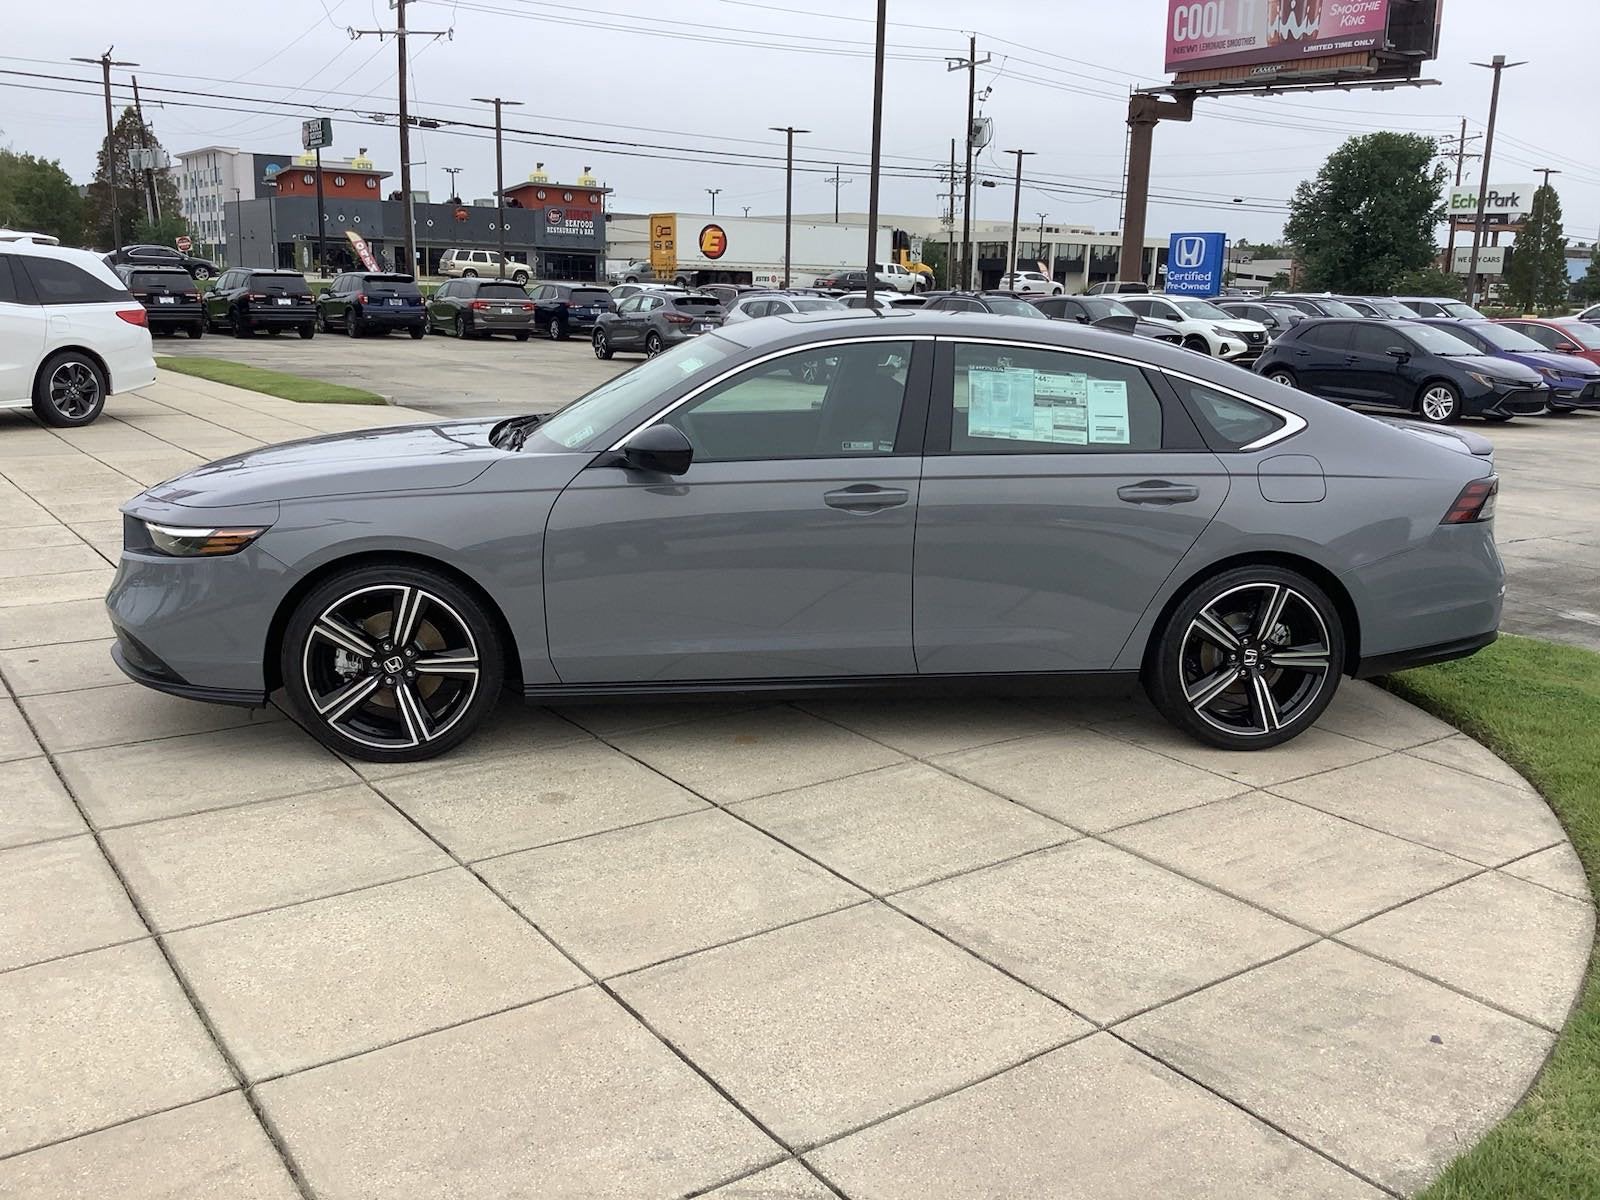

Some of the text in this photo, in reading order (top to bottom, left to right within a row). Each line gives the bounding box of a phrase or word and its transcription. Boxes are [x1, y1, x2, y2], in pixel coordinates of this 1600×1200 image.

[1330, 1, 1381, 16] SMOOTHIE
[1173, 0, 1230, 41] COOL
[1173, 36, 1256, 55] NEW! LEMONADE SMOOTHIES
[1303, 38, 1375, 52] LIMITED TIME ONLY
[1451, 191, 1520, 209] EchPark
[546, 226, 579, 234] RESTAURANT
[565, 219, 594, 228] SEAFOOD
[701, 228, 723, 253] E
[1168, 271, 1212, 280] Certified
[1167, 281, 1211, 290] Pre-Owned
